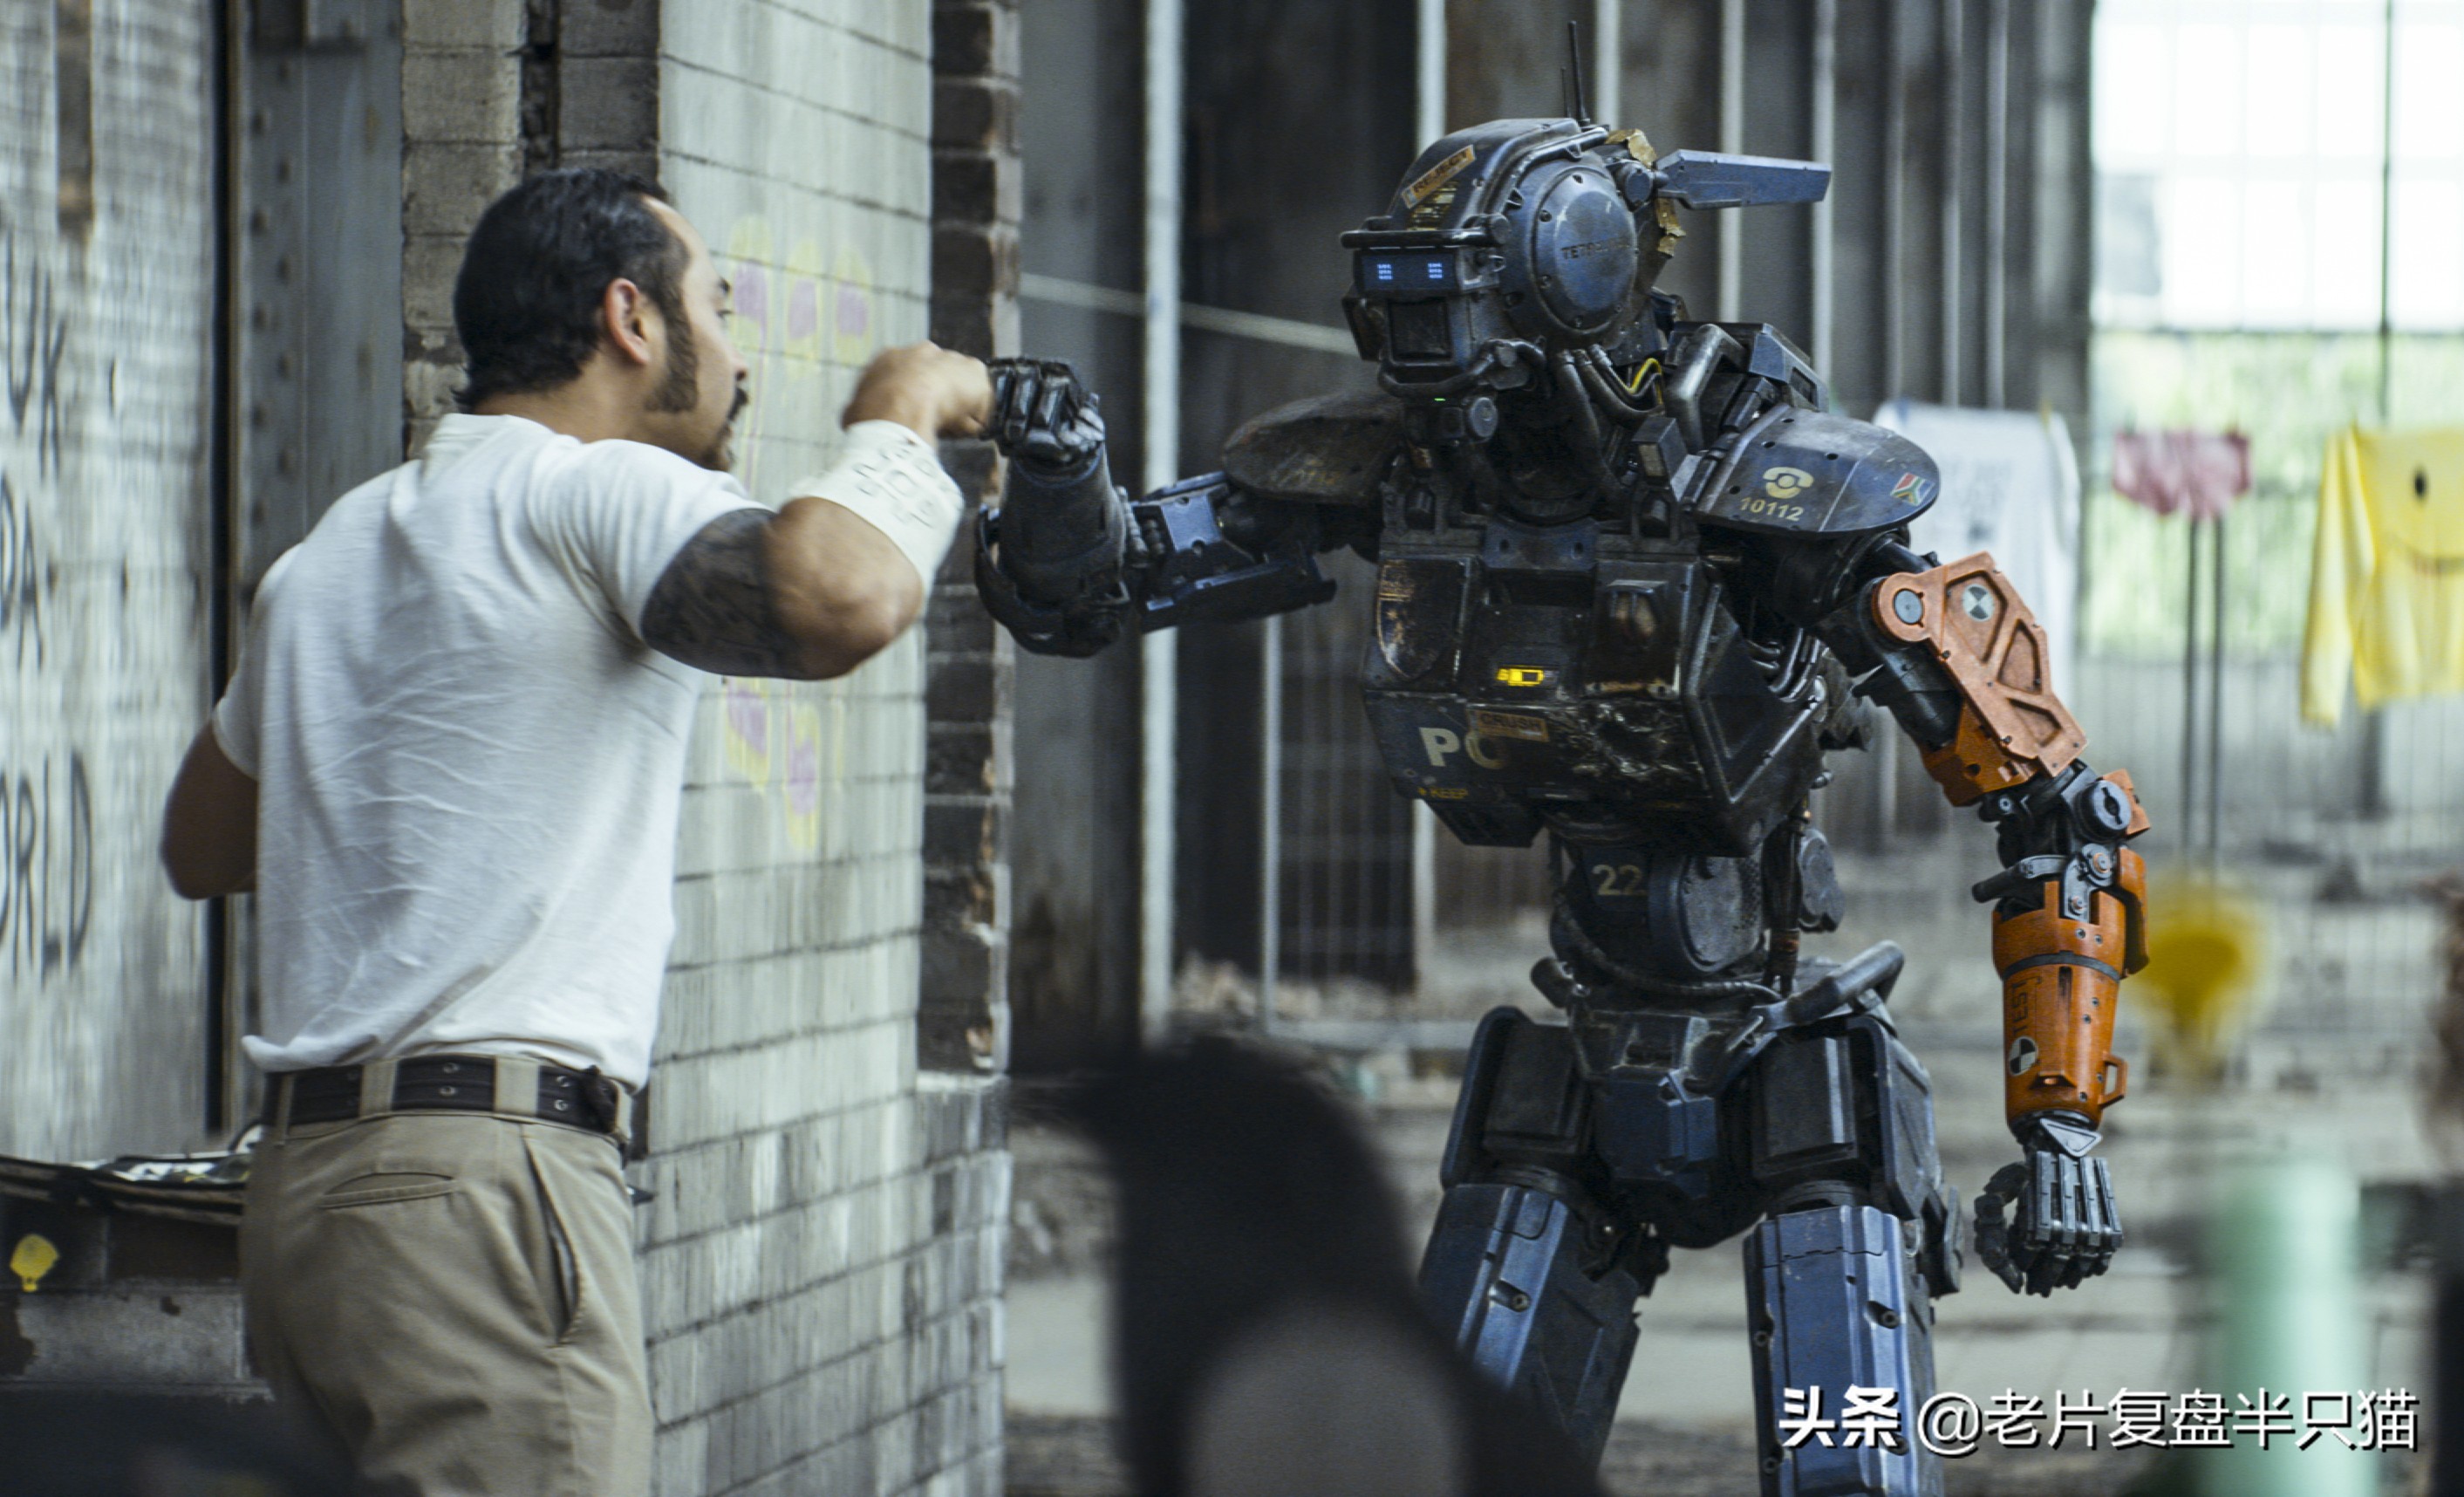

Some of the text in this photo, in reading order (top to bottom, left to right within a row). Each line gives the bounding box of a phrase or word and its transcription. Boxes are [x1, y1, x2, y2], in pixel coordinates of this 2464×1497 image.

[1740, 496, 1805, 522] 10112
[1592, 864, 1648, 897] 22
[2010, 980, 2029, 1036] TEST
